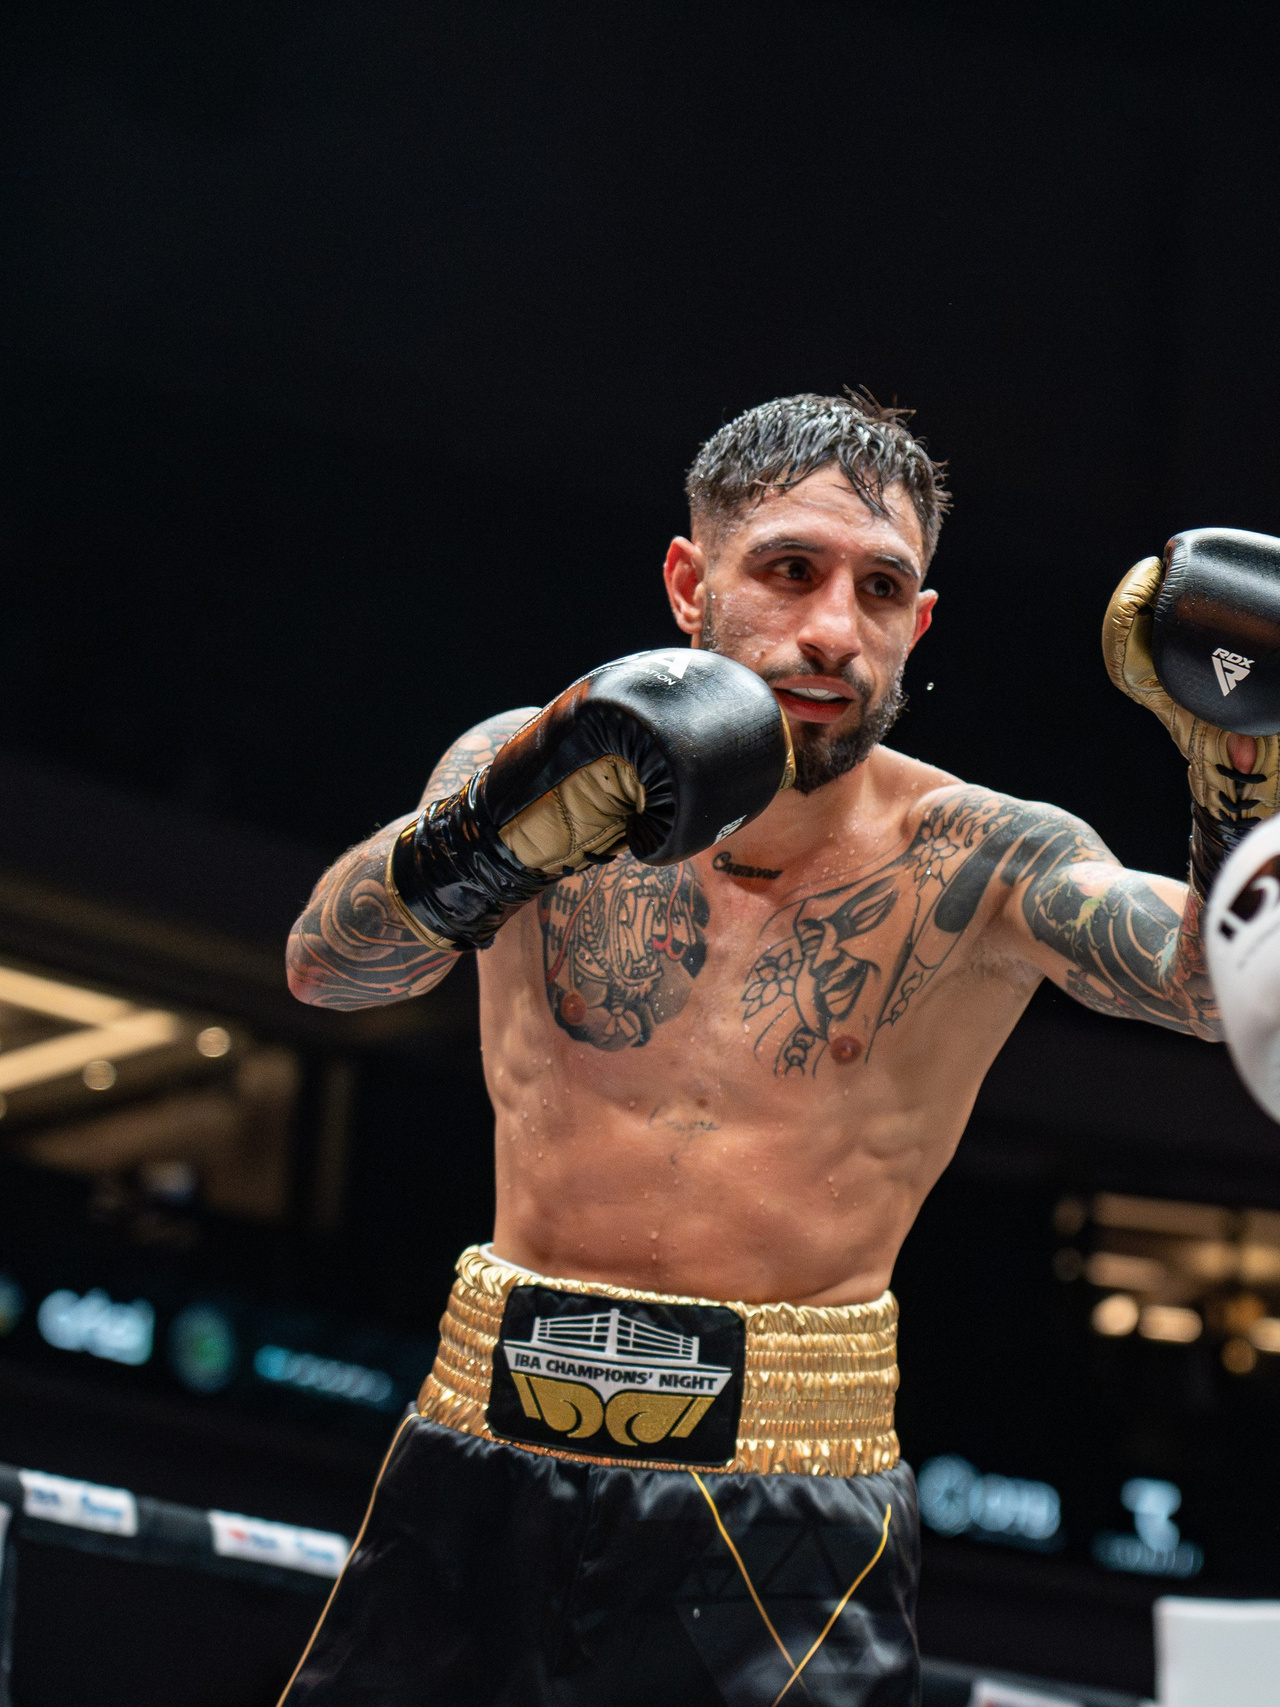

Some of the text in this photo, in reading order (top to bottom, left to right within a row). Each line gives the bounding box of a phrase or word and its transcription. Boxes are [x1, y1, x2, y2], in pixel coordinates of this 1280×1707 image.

[1212, 647, 1255, 669] RDX
[514, 1352, 718, 1391] IBA CHAMPIONS' NIGHT
